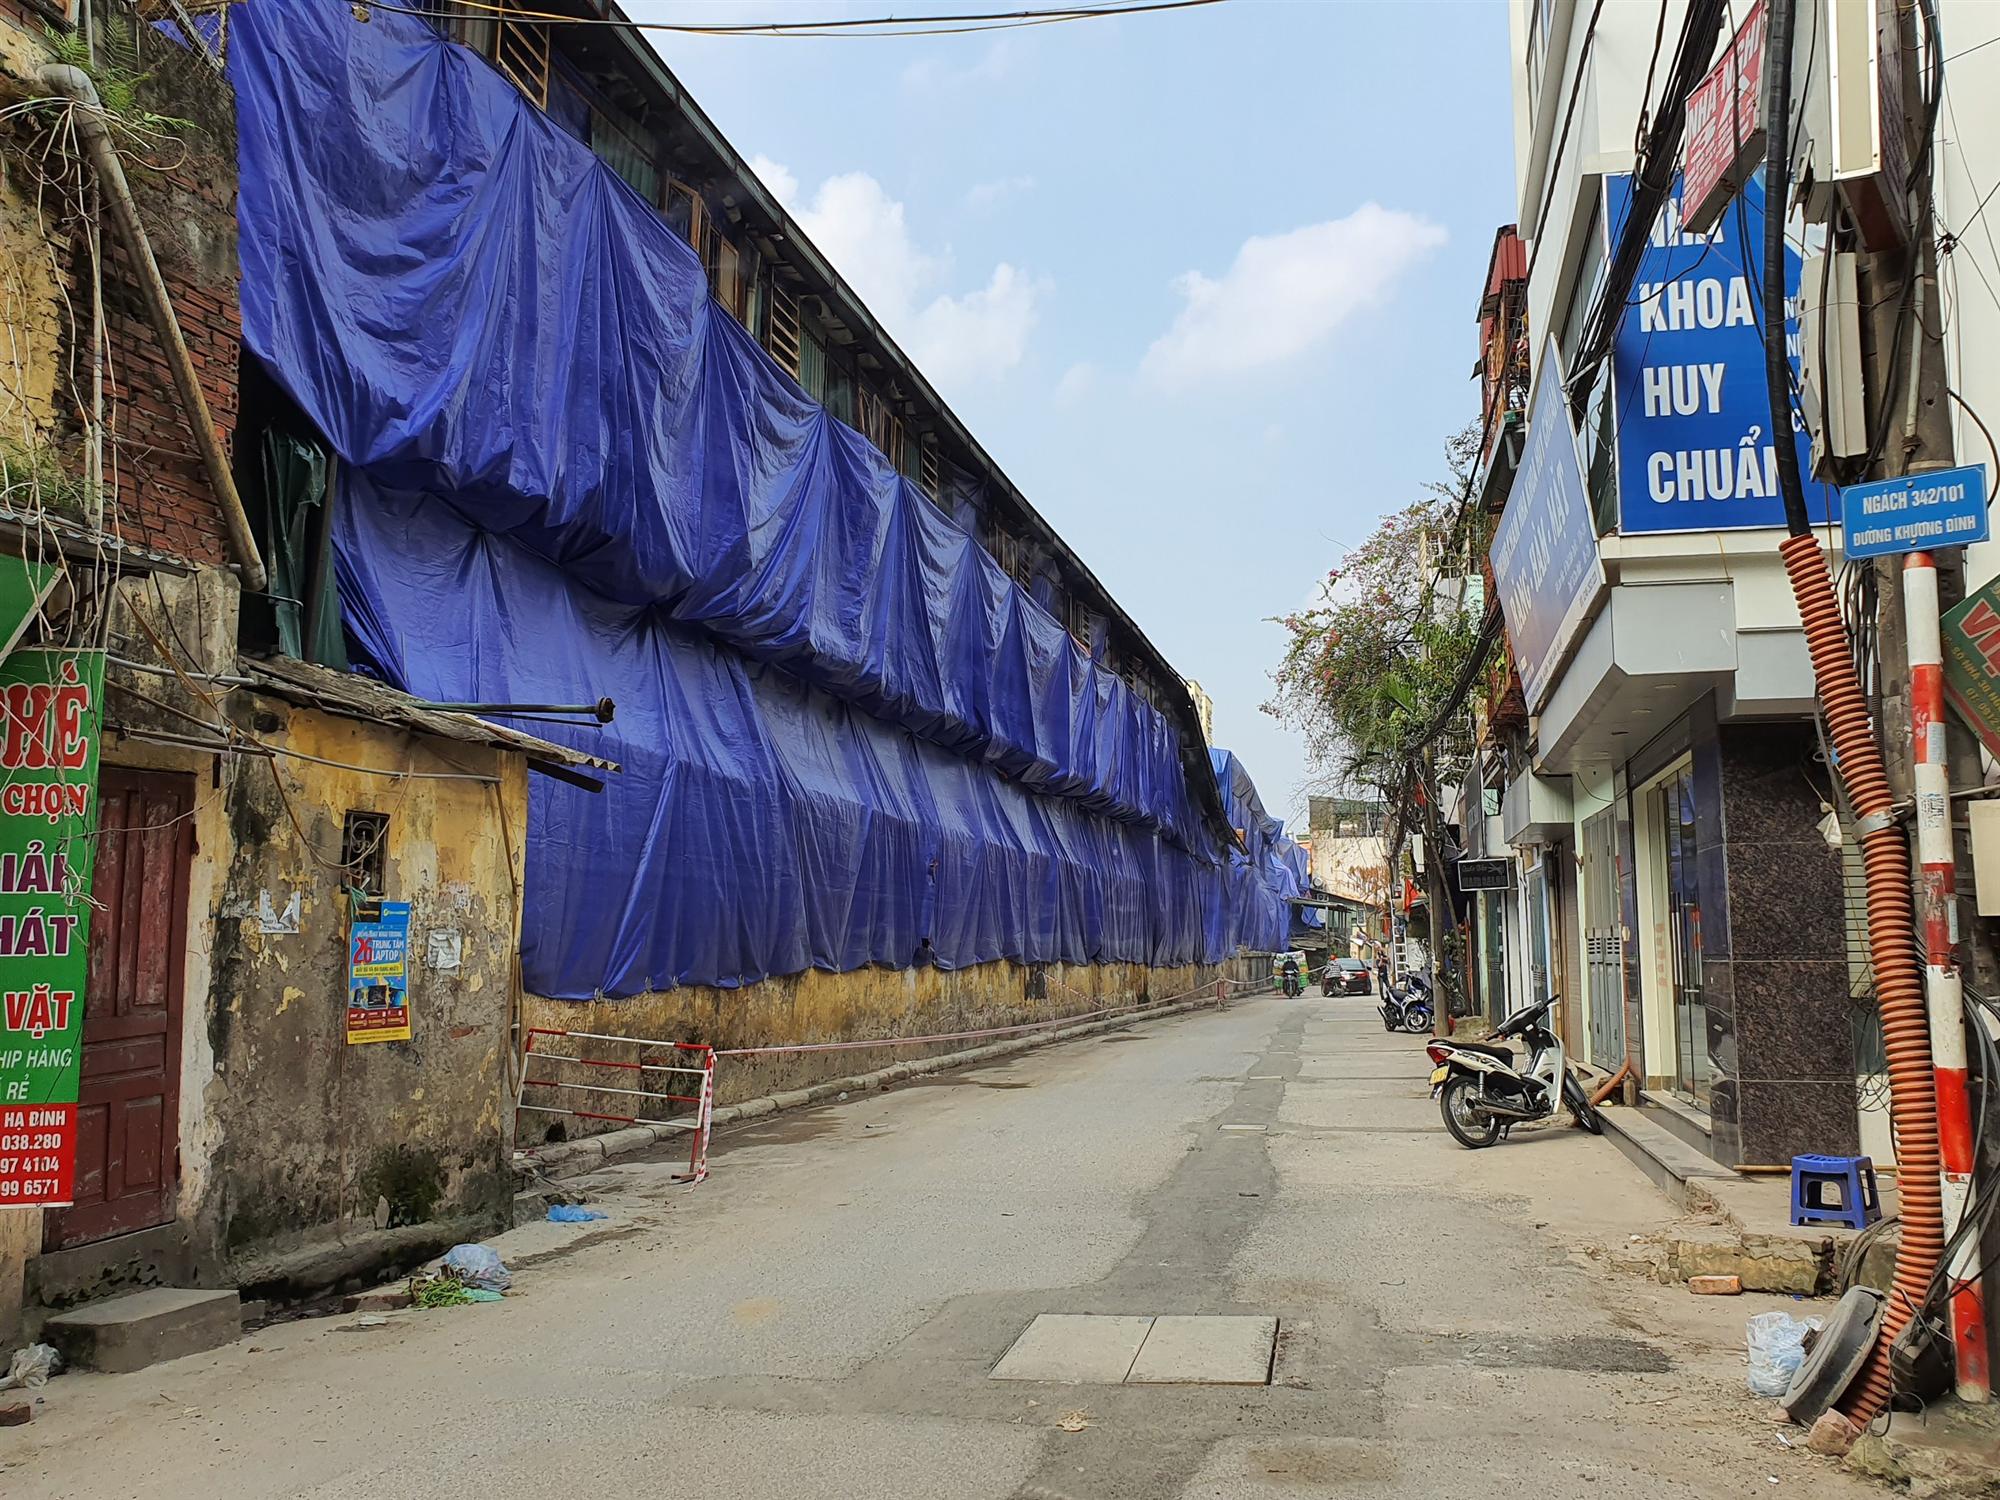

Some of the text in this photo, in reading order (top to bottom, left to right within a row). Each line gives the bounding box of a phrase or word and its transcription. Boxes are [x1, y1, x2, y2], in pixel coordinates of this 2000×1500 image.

[1639, 276, 1755, 333] KHOA
[1643, 363, 1725, 418] HUY
[1863, 483, 1965, 515] NGÁCH 342/101
[1945, 513, 1976, 533] ĐÌNH
[1508, 562, 1533, 640] RĂNG
[1527, 513, 1552, 594] HÀM
[0, 659, 88, 770] HÈ
[3, 783, 88, 824] CHỌN
[354, 937, 373, 963] 26
[372, 949, 399, 961] LAPTOP
[373, 940, 392, 949] TRUNG
[5, 983, 75, 1038] VẶT
[26, 1044, 73, 1068] HÀNG
[6, 1073, 30, 1100] RẺ
[4, 1108, 66, 1130] HẠ ĐÌNH
[22, 1156, 60, 1173] 4104
[23, 1179, 59, 1195] 6571
